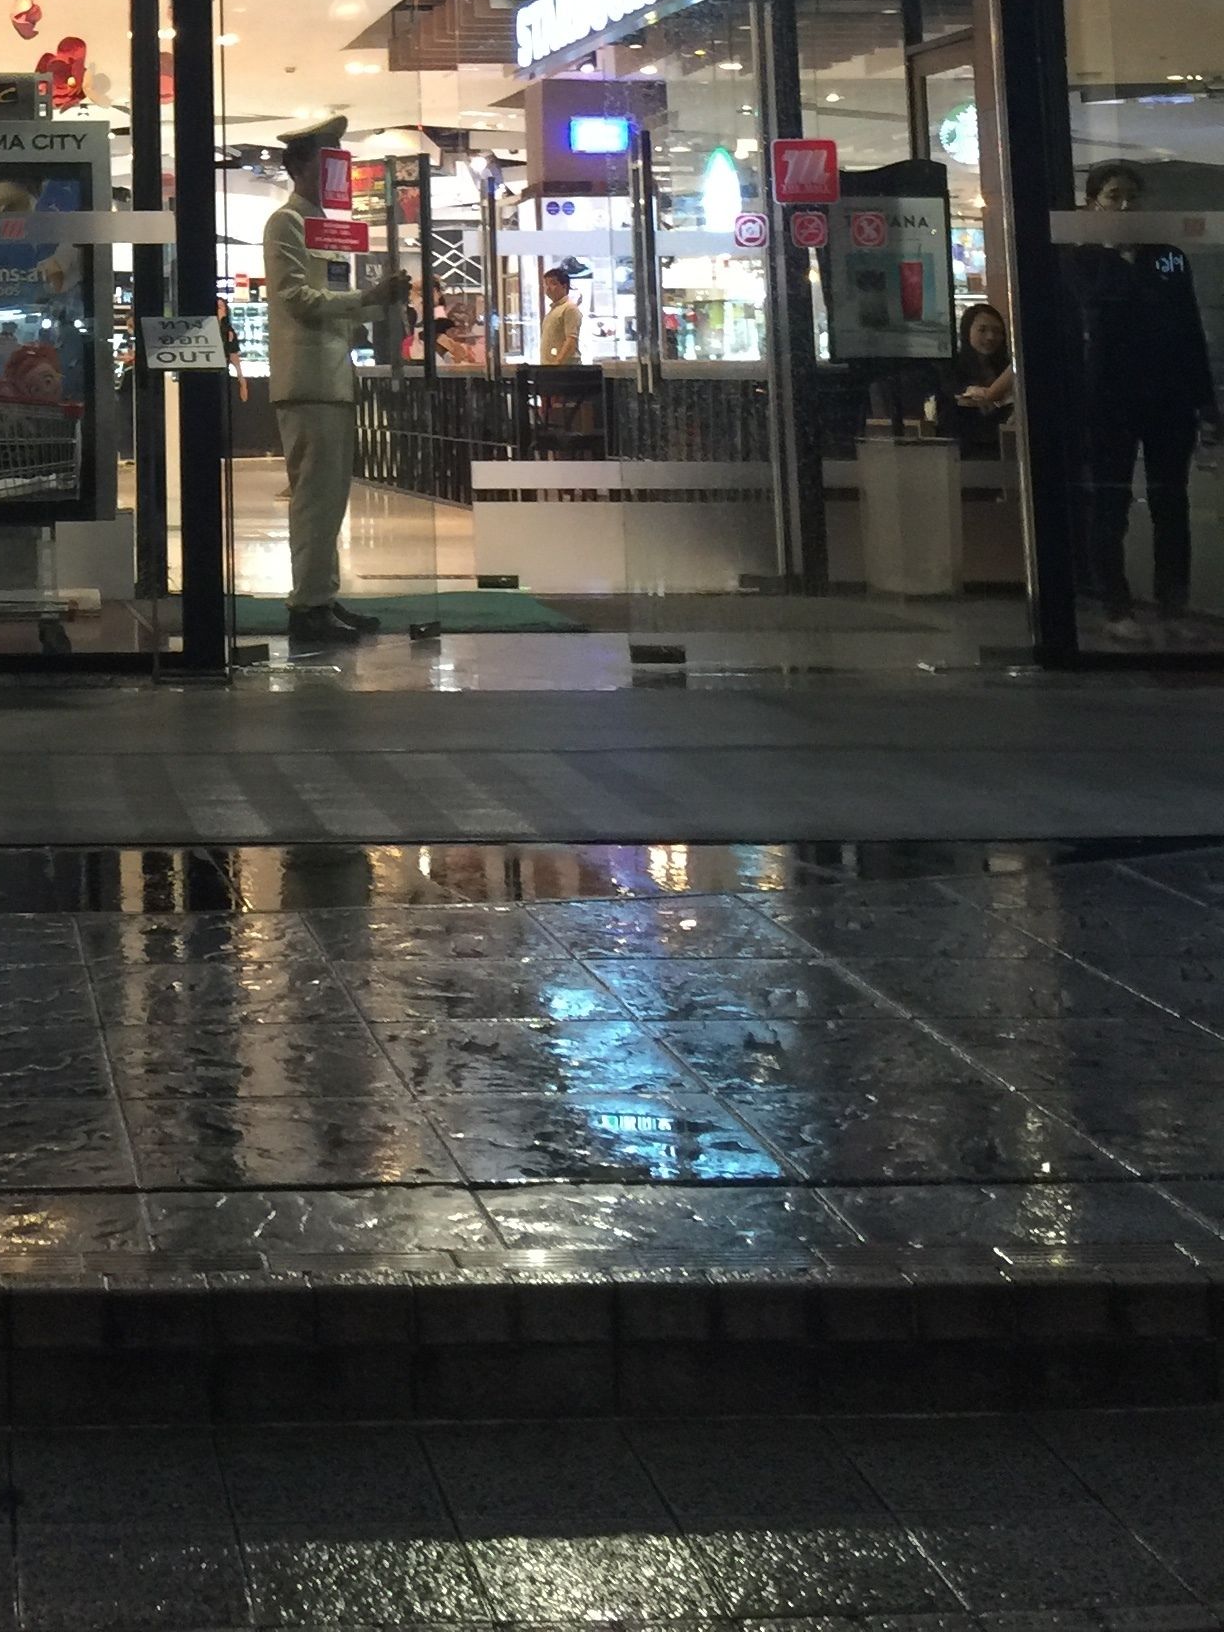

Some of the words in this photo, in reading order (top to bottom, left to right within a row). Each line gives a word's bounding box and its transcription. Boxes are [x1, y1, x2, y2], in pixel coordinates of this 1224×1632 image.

[32, 133, 89, 151] CITY
[158, 320, 203, 330] ทาง
[159, 334, 209, 345] ออก
[156, 351, 216, 363] OUT
